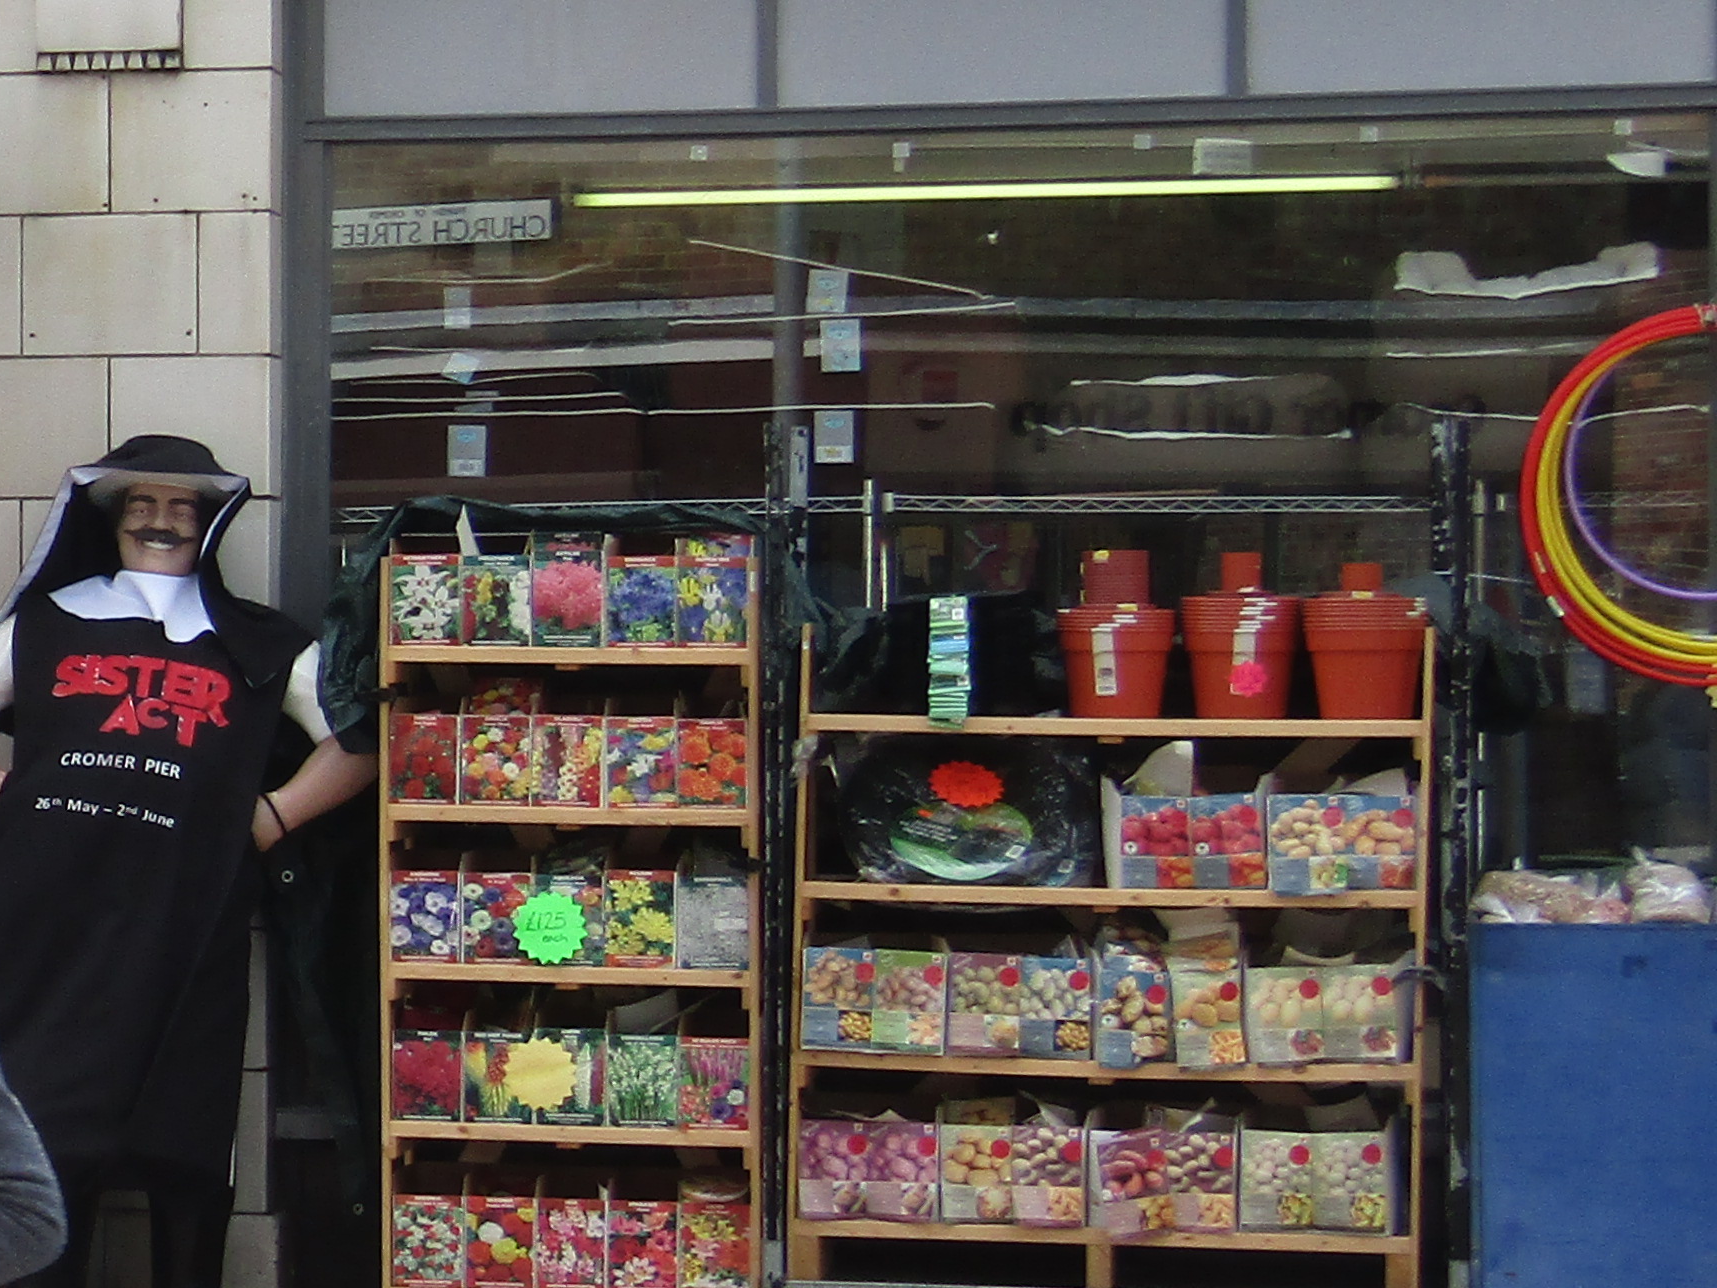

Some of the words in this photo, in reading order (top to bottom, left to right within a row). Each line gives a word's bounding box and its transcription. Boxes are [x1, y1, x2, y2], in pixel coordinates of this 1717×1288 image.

[52, 653, 232, 728] SISTER
[99, 696, 206, 748] ACT
[60, 751, 135, 770] CROMER
[144, 759, 181, 780] PIER
[35, 797, 63, 810] 26th
[67, 798, 99, 816] May
[117, 803, 138, 817] 2nd
[142, 807, 175, 828] June
